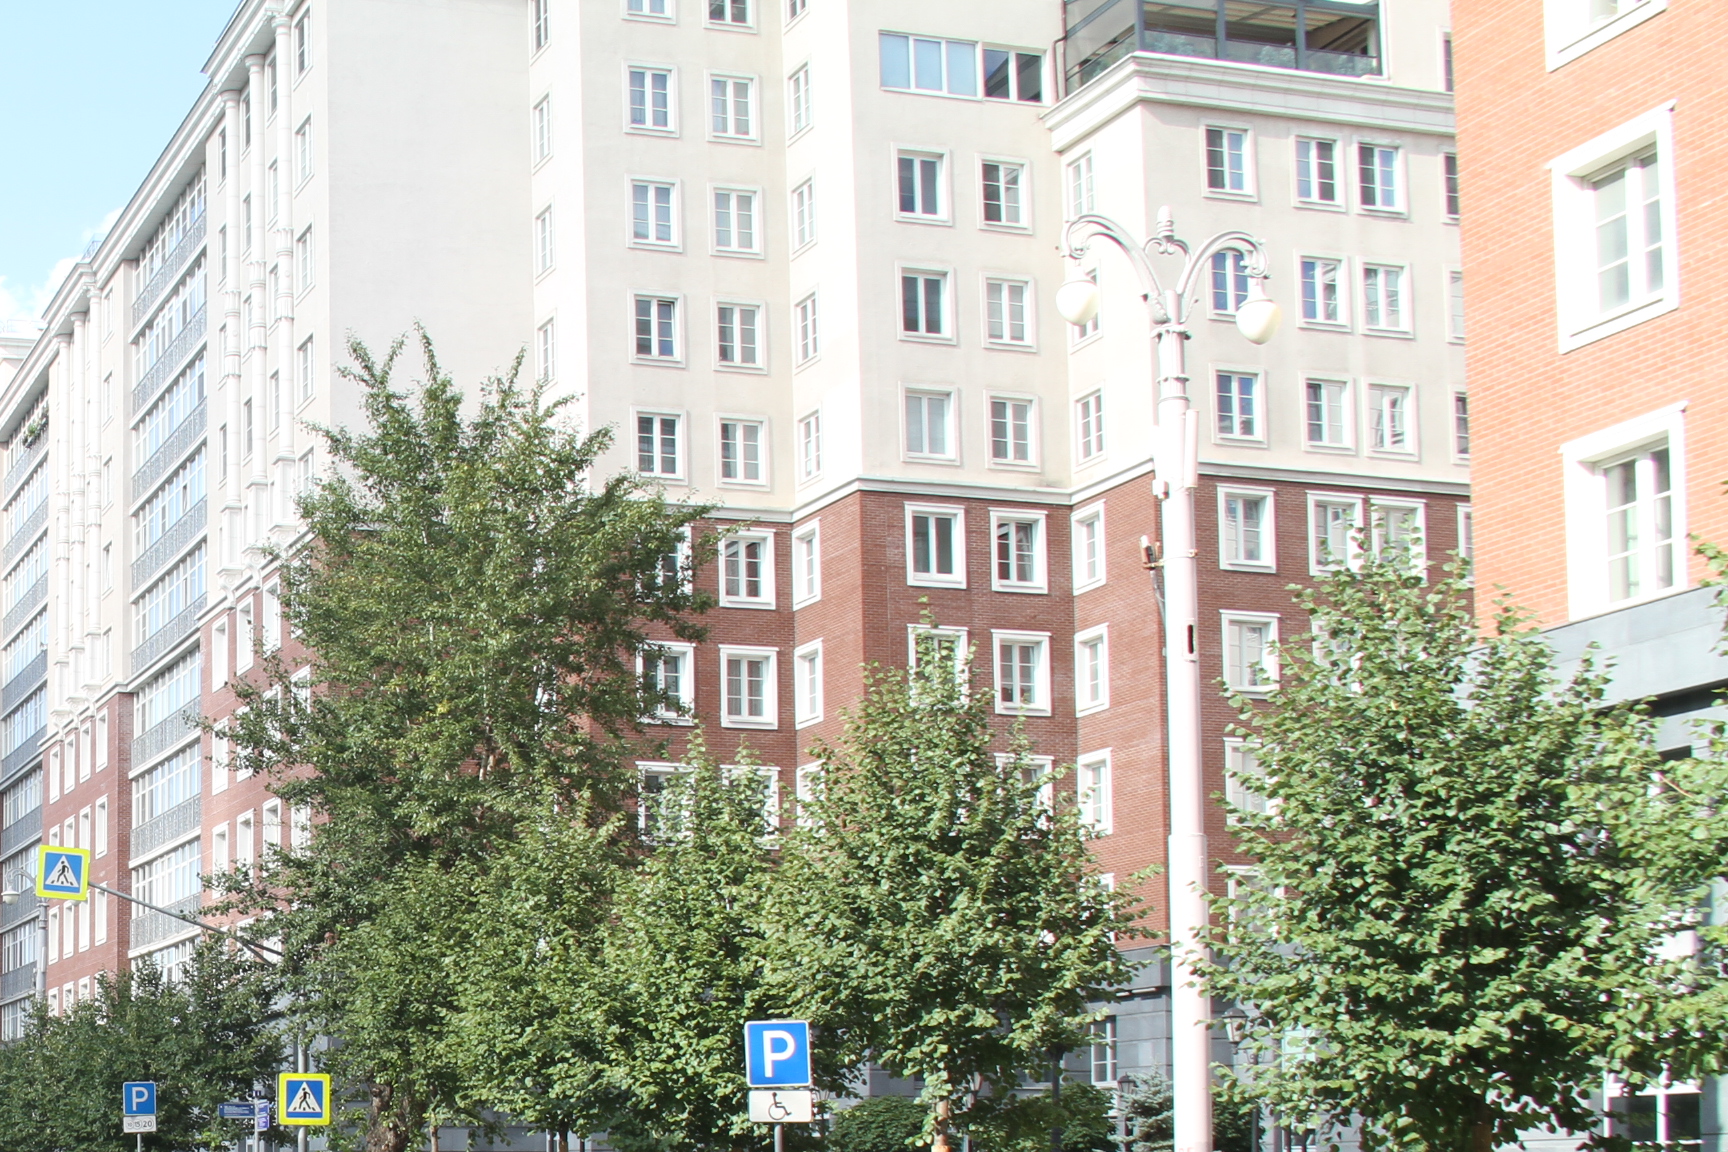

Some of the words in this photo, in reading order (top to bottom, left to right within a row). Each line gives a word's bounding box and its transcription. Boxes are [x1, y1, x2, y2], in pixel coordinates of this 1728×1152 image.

[762, 1030, 796, 1078] P
[131, 1086, 149, 1111] P
[143, 1120, 153, 1128] 20
